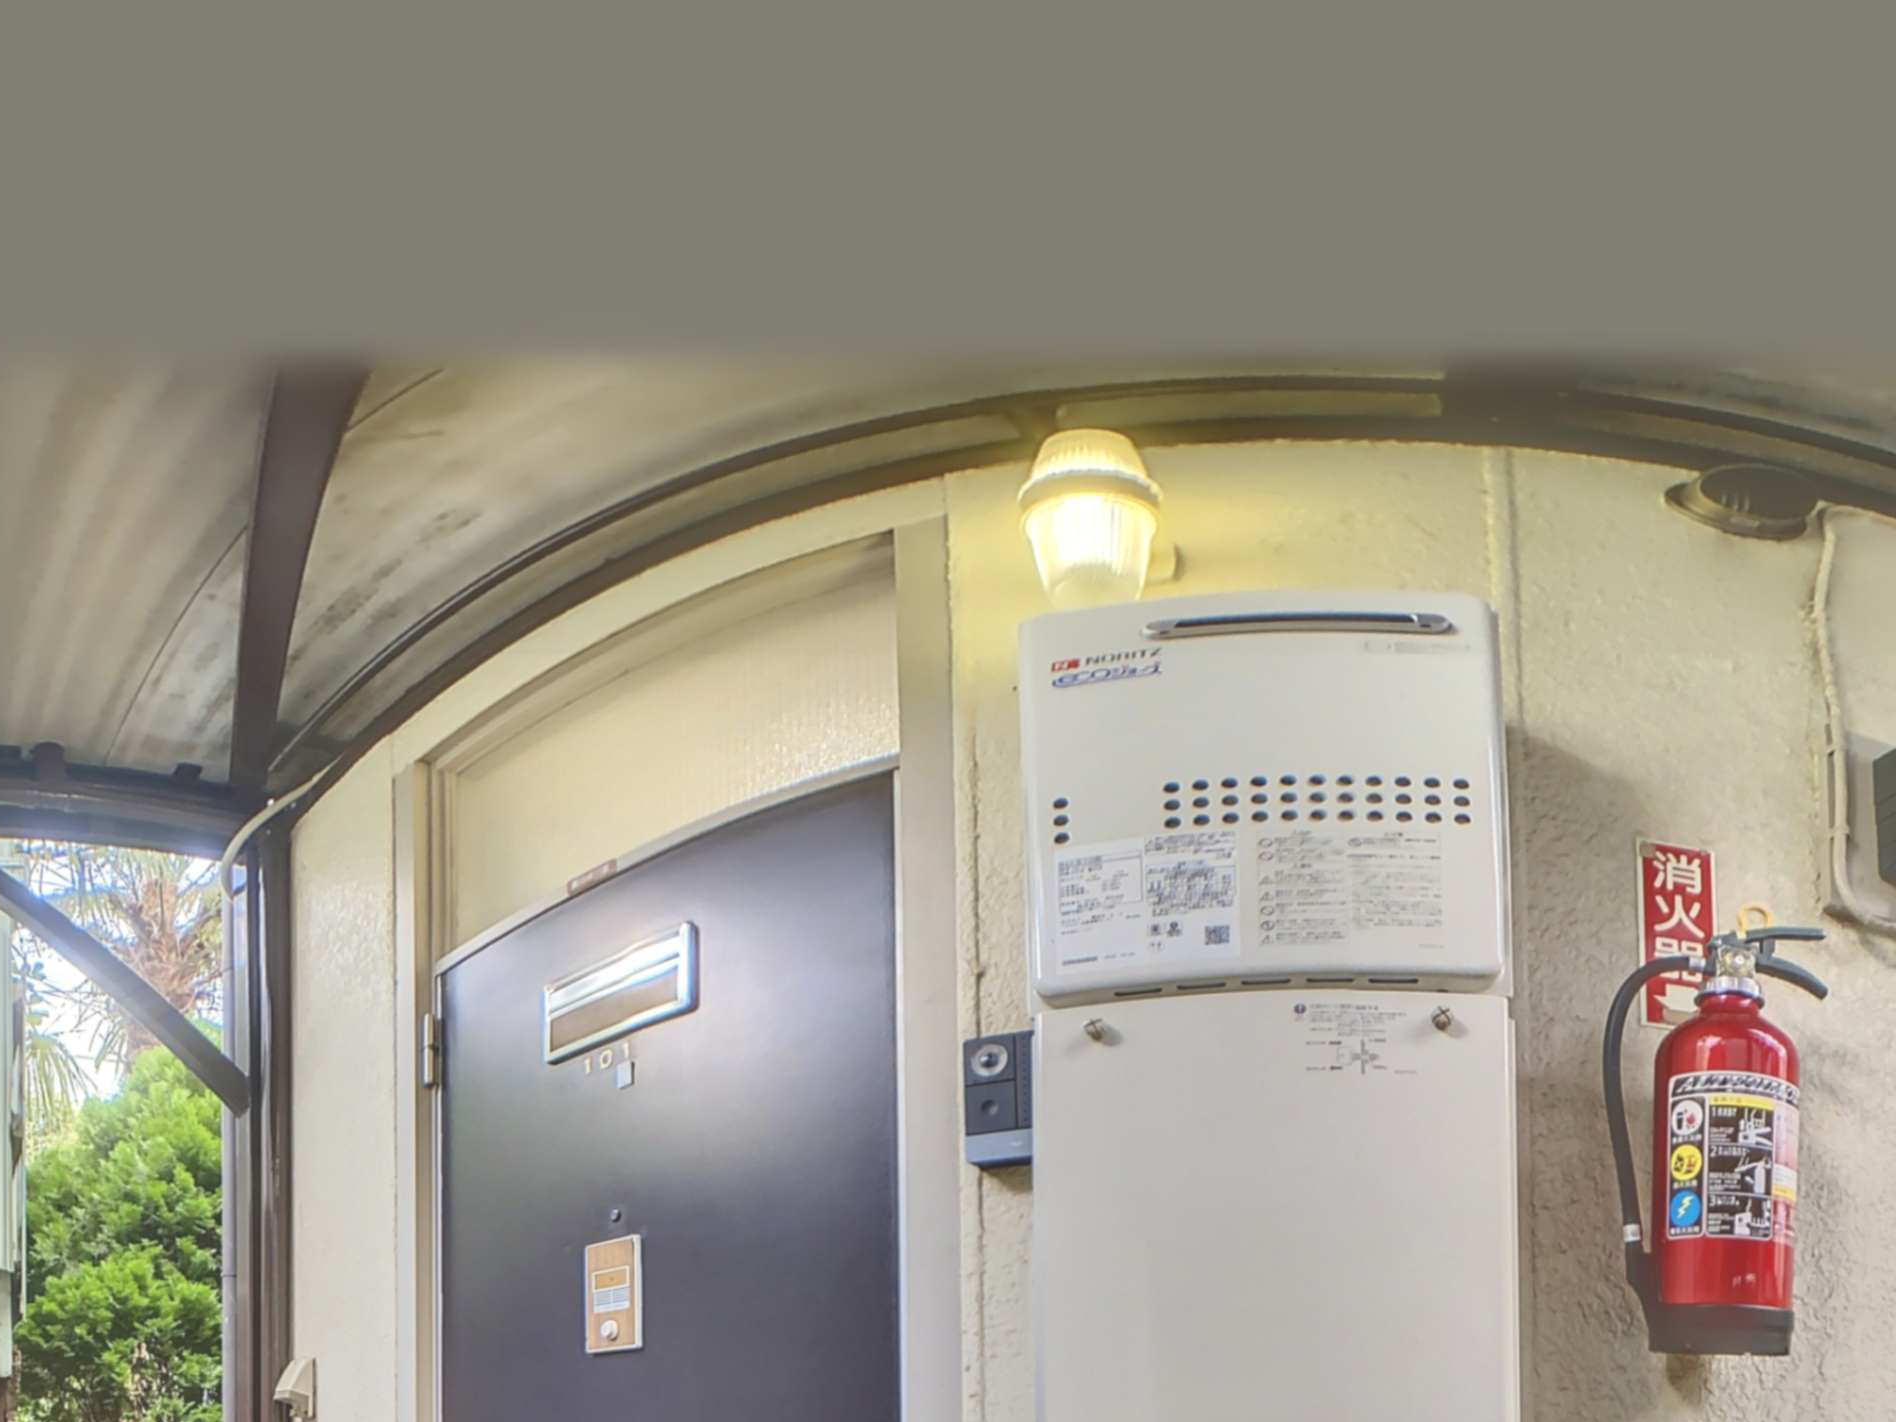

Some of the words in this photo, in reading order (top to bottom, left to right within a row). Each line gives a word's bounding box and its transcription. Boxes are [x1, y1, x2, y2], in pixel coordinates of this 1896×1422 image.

[1653, 850, 1705, 983] 消火器
[584, 1040, 630, 1075] 101
